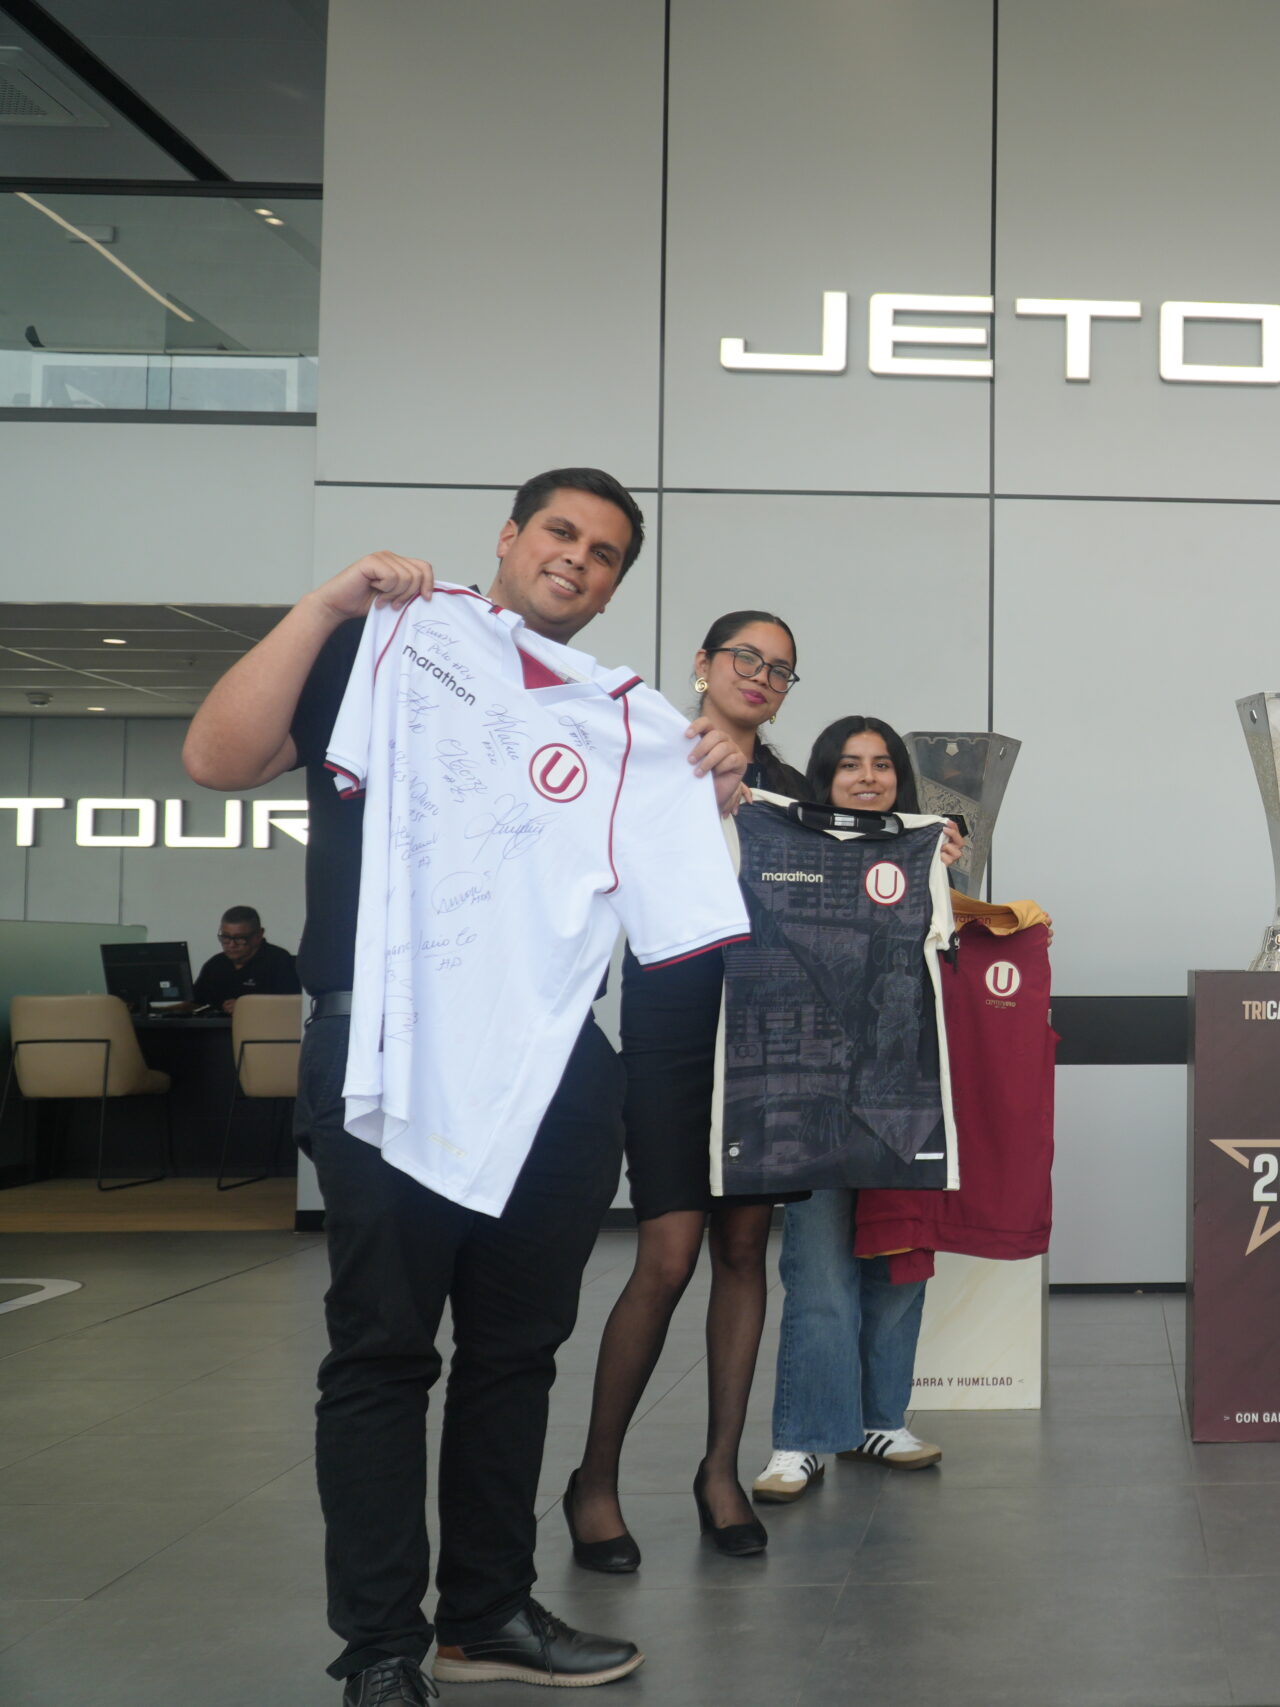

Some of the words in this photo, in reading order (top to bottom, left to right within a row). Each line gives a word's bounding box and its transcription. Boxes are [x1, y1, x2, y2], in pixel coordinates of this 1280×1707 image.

[402, 645, 477, 706] marathon
[761, 870, 824, 883] marathon
[947, 1377, 955, 1387] Y
[957, 1376, 1013, 1387] HUMILDAD
[1235, 1412, 1259, 1424] CON
